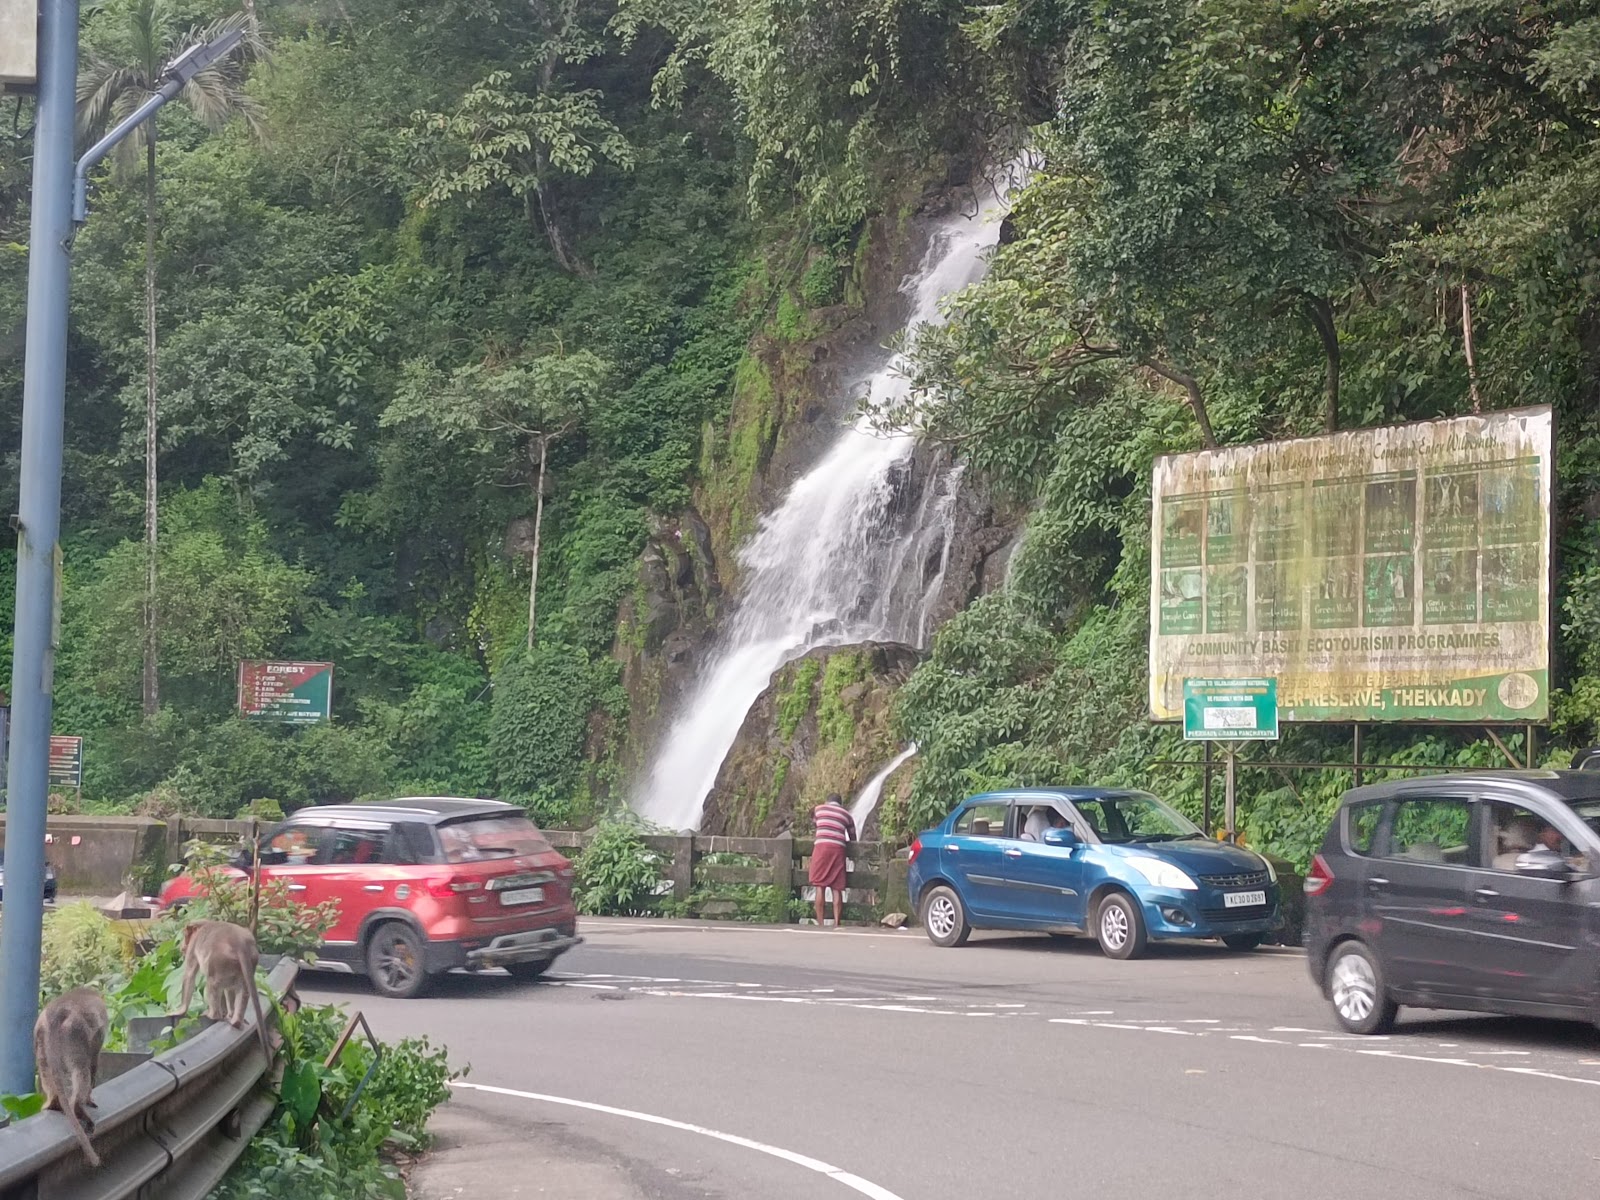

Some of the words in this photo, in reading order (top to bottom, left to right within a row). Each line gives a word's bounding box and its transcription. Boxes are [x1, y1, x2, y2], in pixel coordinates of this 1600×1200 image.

[1419, 437, 1444, 455] Enjoy
[1188, 641, 1257, 656] COMMUNITY
[1307, 634, 1393, 652] ECOTOURISM
[1398, 632, 1500, 651] PROGRAMMES
[267, 665, 305, 673] FOREST
[1278, 692, 1305, 707] GER
[1309, 688, 1387, 710] RESERVE,
[1391, 688, 1488, 706] THEKKADY
